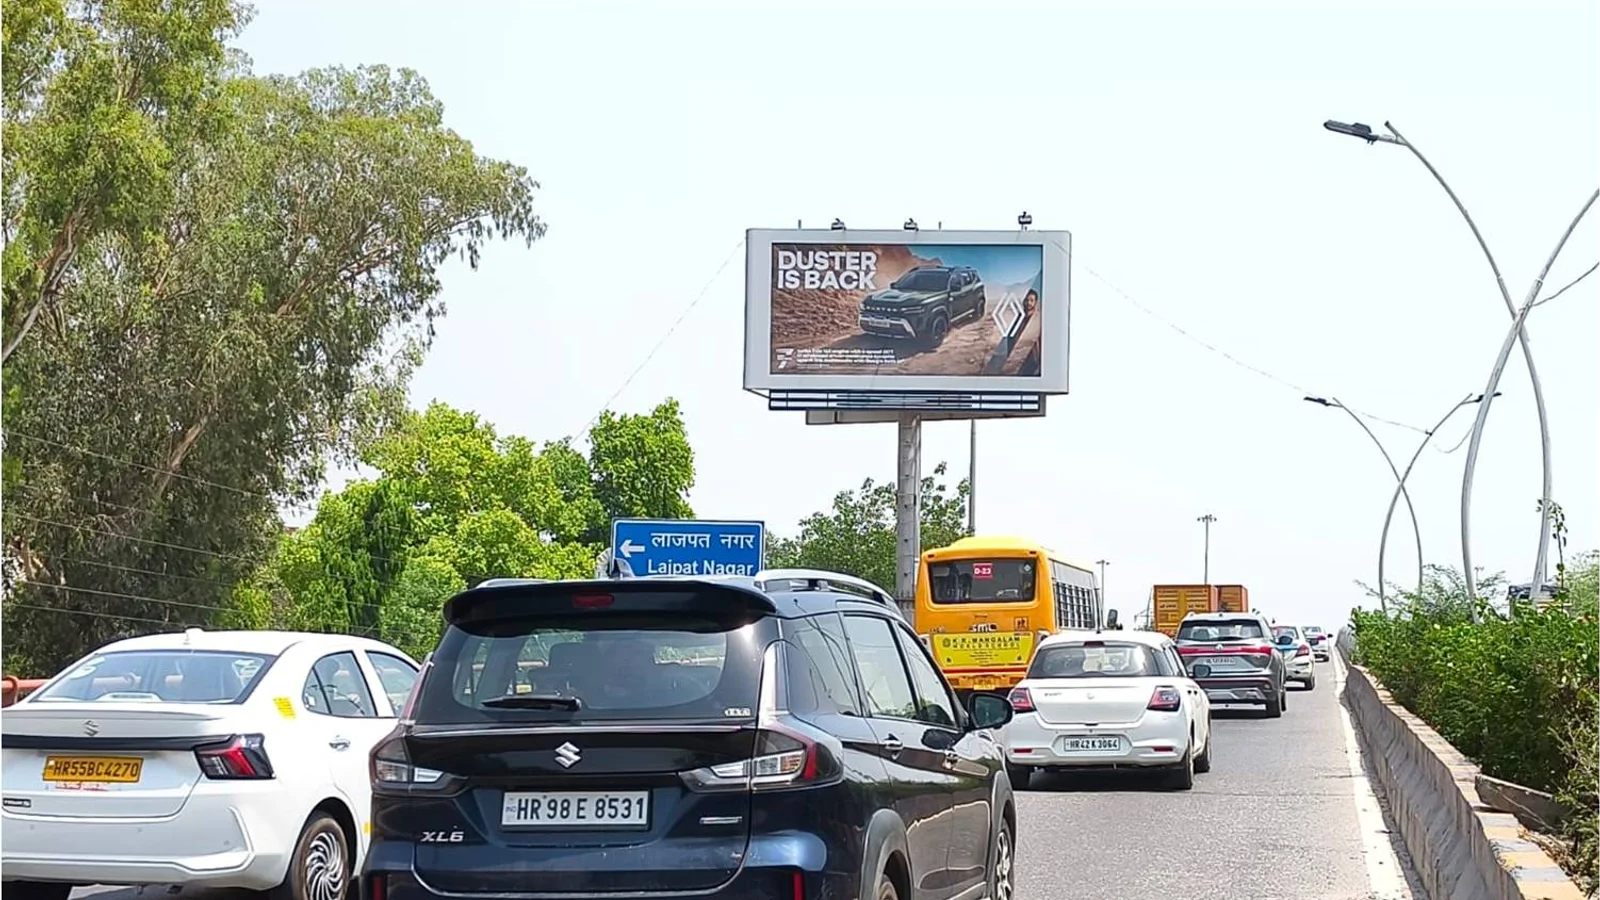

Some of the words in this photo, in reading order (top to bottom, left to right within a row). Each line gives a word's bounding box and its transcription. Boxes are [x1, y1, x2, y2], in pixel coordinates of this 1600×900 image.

[778, 250, 877, 270] DUSTER
[778, 270, 800, 289] IS
[804, 270, 876, 289] BACK
[651, 533, 711, 548] लाजपत
[719, 534, 755, 549] नगर
[648, 559, 698, 575] Lajpat
[703, 560, 754, 576] Nagar
[1098, 739, 1117, 748] 3064
[53, 761, 139, 777] HR55BC4270
[517, 798, 541, 820] HR
[547, 799, 571, 820] 98
[576, 798, 588, 819] E
[595, 797, 645, 819] 8531
[421, 831, 464, 842] XL6
